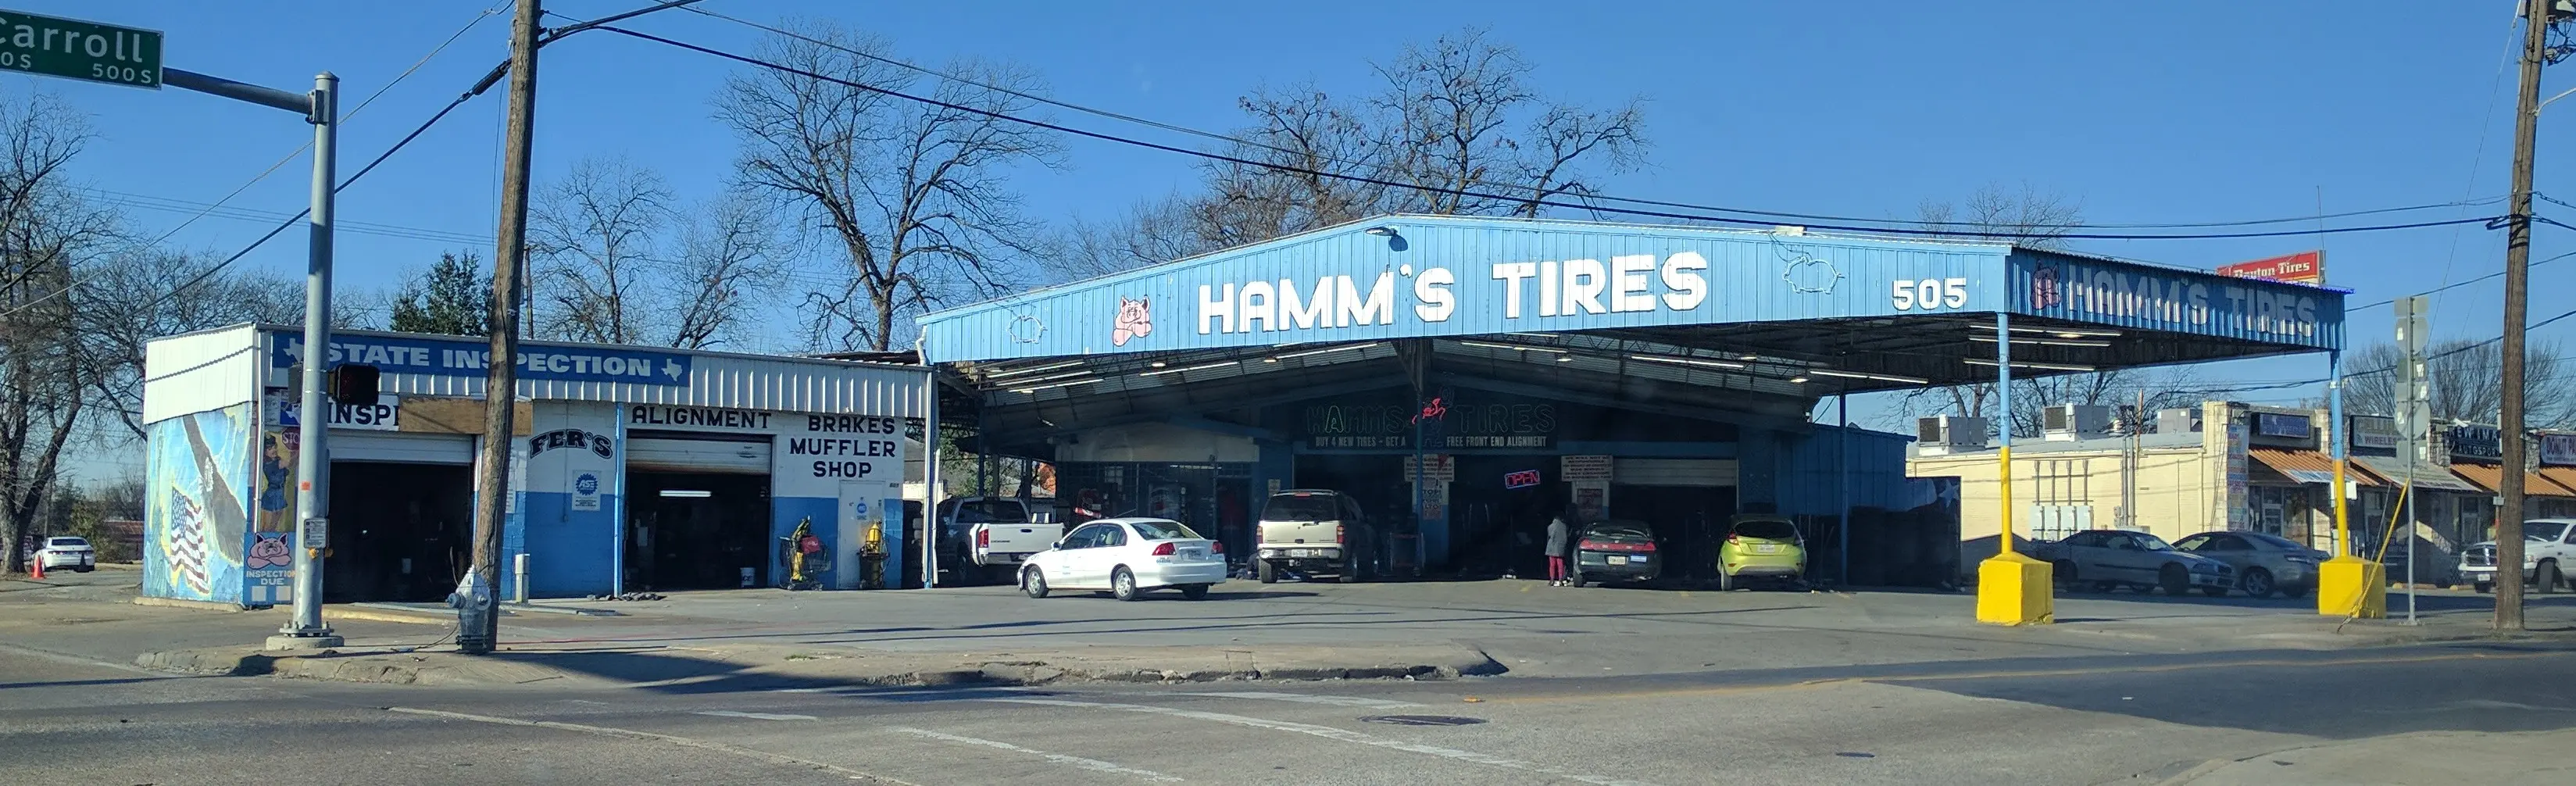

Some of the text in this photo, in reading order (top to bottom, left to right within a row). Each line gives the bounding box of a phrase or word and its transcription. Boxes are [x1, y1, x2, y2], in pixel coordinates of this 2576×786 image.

[92, 63, 152, 84] 500S
[2278, 261, 2310, 274] Tires
[1199, 252, 1708, 334] HAMM'S TIRES
[1892, 277, 1967, 311] 505
[2068, 264, 2316, 337] HAMM'S TIRES
[329, 342, 430, 366] STATE
[631, 406, 773, 429] ALIGNMENT
[808, 415, 895, 434] BRAKES
[1452, 403, 1557, 434] TIRES
[283, 432, 299, 444] STO
[529, 428, 613, 459] FER'S
[1316, 436, 1329, 447] BUY
[1331, 436, 1338, 447] 4
[1338, 436, 1354, 447] NEW
[1356, 436, 1377, 447] TIRES
[1385, 436, 1400, 447] GET
[1446, 436, 1463, 447] FREE
[1466, 436, 1488, 447] FRONT
[1490, 436, 1505, 447] END
[1507, 436, 1547, 447] ALIGNMENT
[2476, 428, 2499, 442] IMA
[789, 437, 896, 458] MUFFLER
[813, 460, 873, 478] SHOP
[1507, 472, 1538, 486] OPEN
[578, 479, 595, 488] ASE
